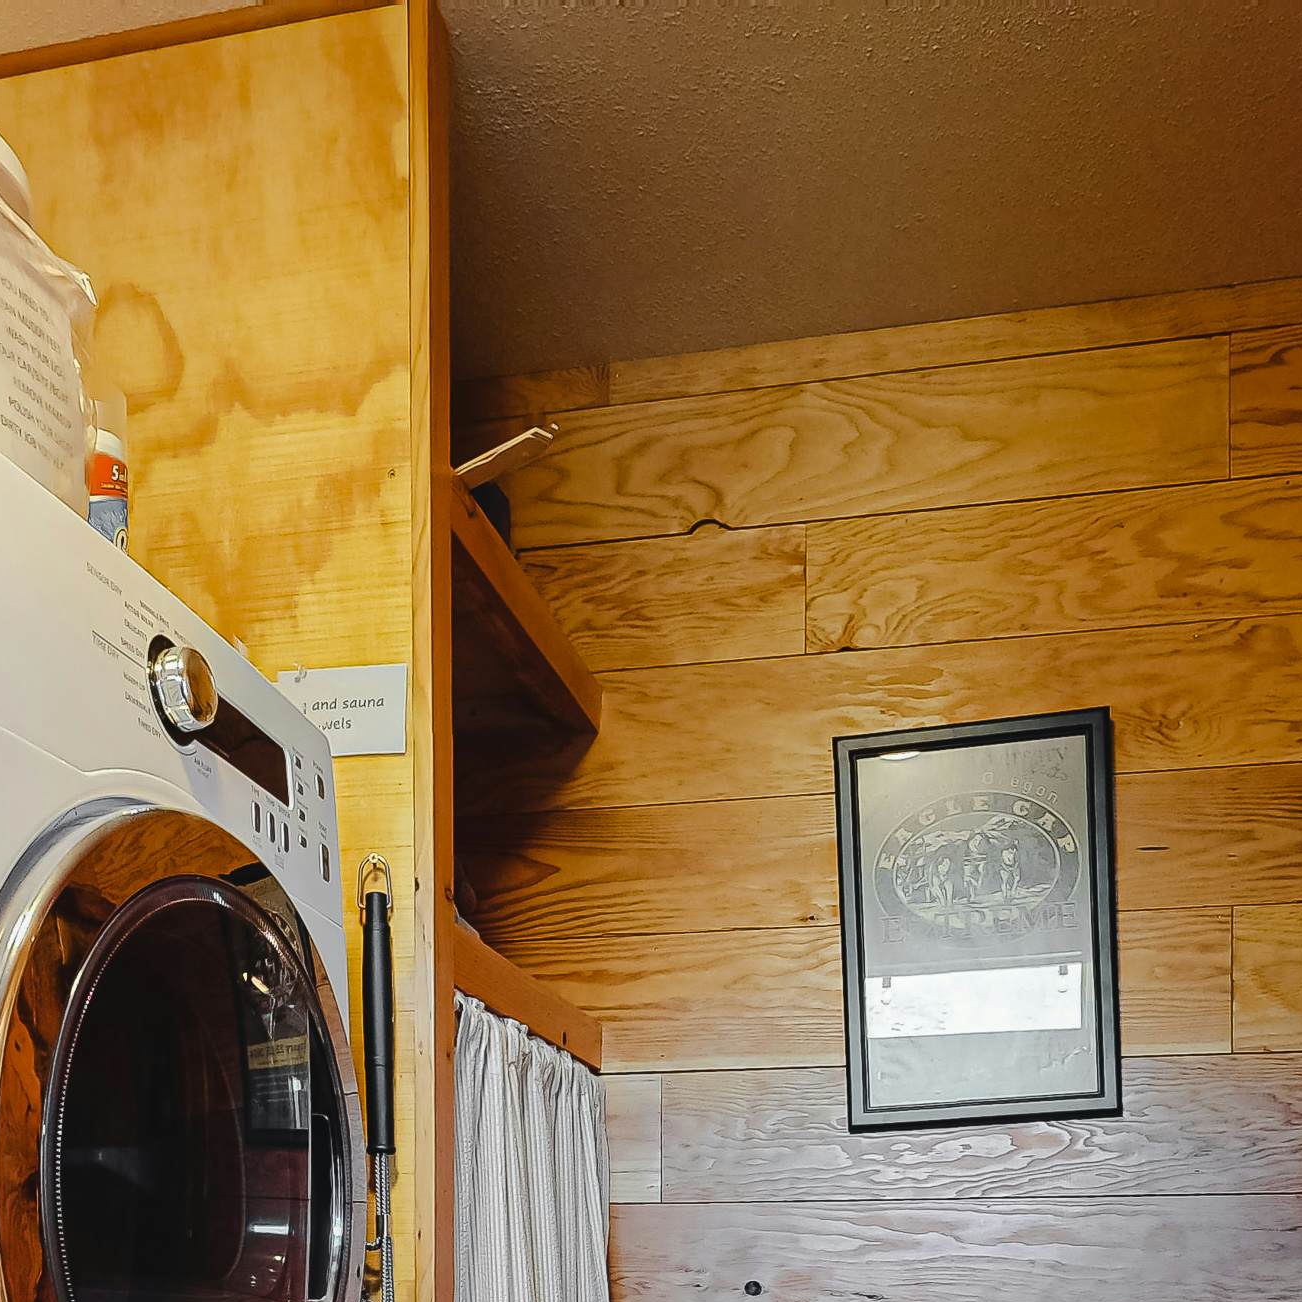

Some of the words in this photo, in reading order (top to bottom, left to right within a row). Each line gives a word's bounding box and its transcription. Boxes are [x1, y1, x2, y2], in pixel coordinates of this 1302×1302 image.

[0, 414, 22, 438] DIRTY
[311, 698, 337, 711] and
[342, 697, 385, 710] sauna
[318, 717, 352, 731] wels
[982, 771, 1058, 805] Oegon
[878, 795, 990, 870] EAGLE
[1013, 799, 1076, 853] GAP
